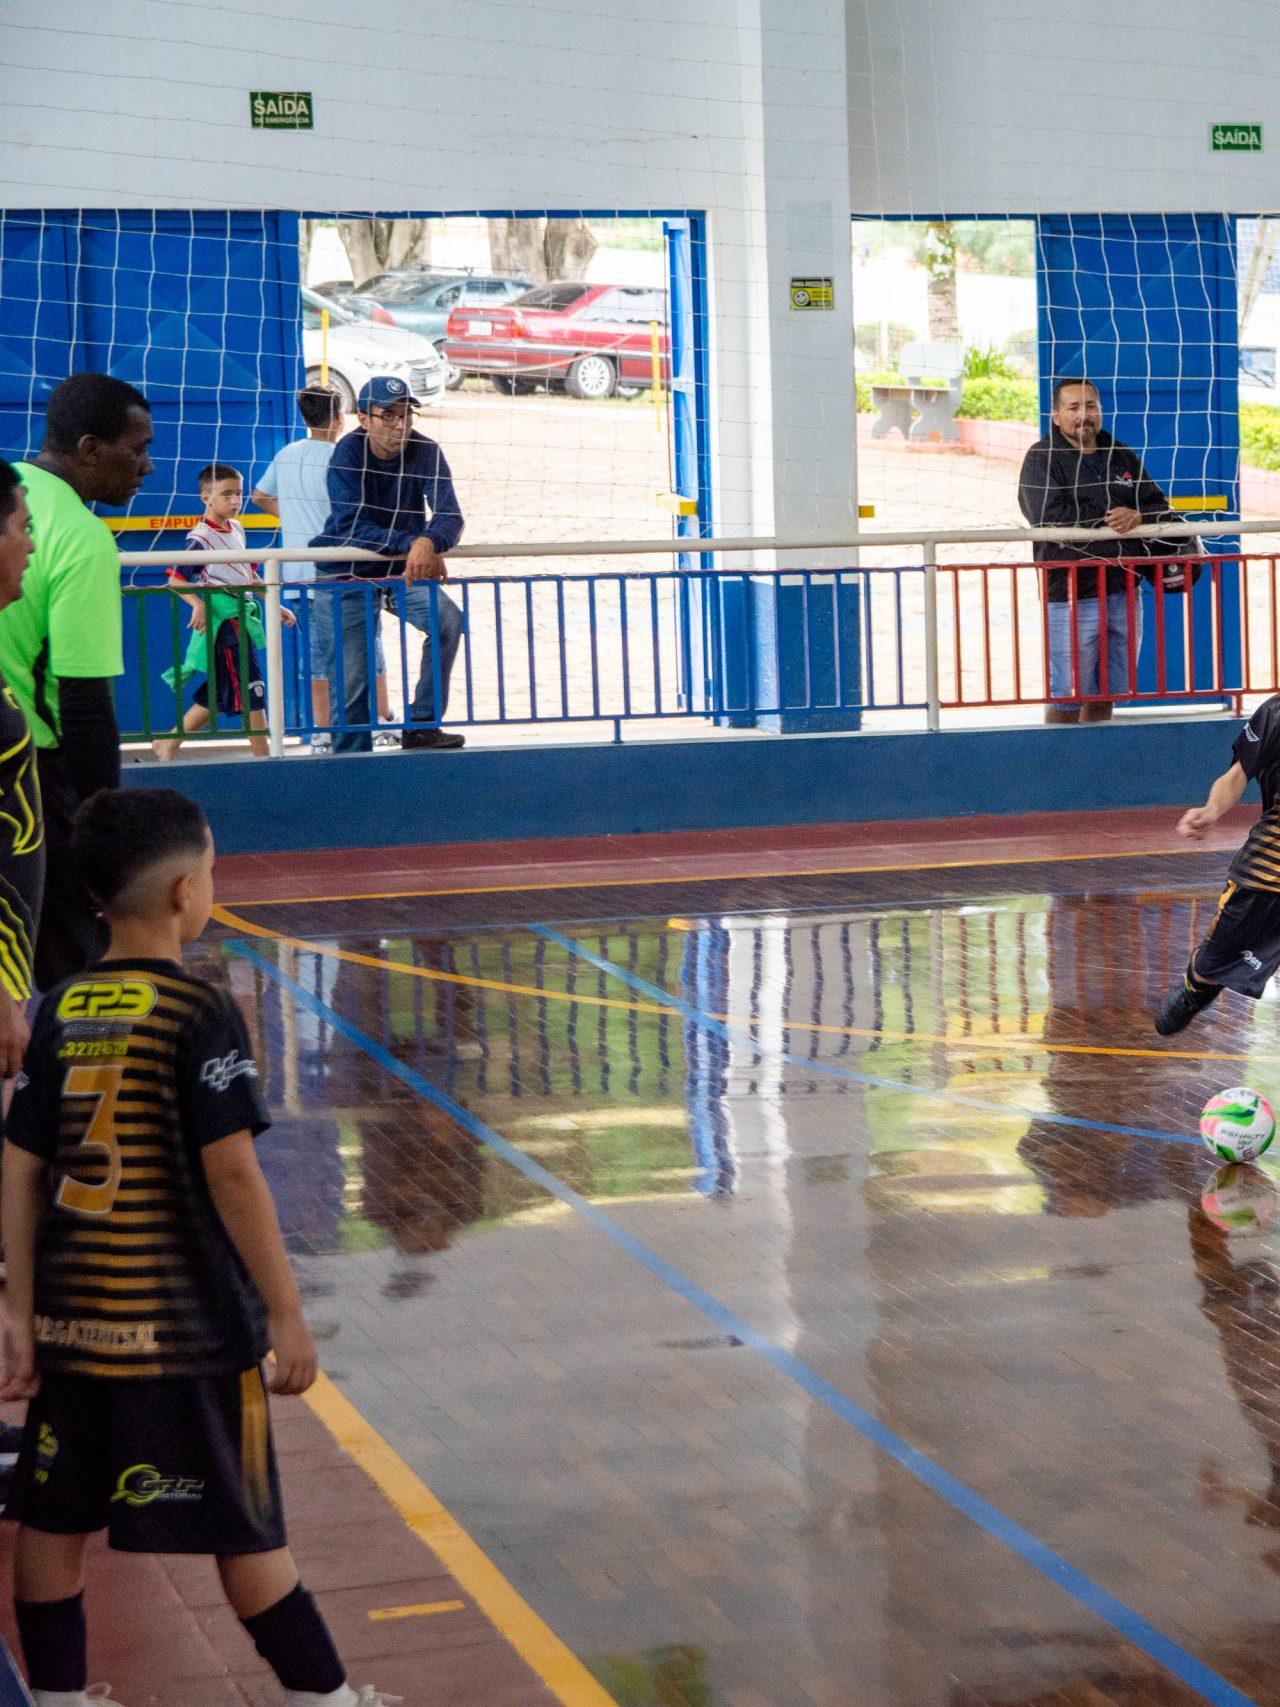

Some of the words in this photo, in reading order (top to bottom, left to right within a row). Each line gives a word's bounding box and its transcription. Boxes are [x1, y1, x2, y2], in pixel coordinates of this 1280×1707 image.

[253, 96, 309, 115] SAÍDA
[1214, 129, 1260, 145] SAÍDA
[55, 1064, 125, 1217] 3
